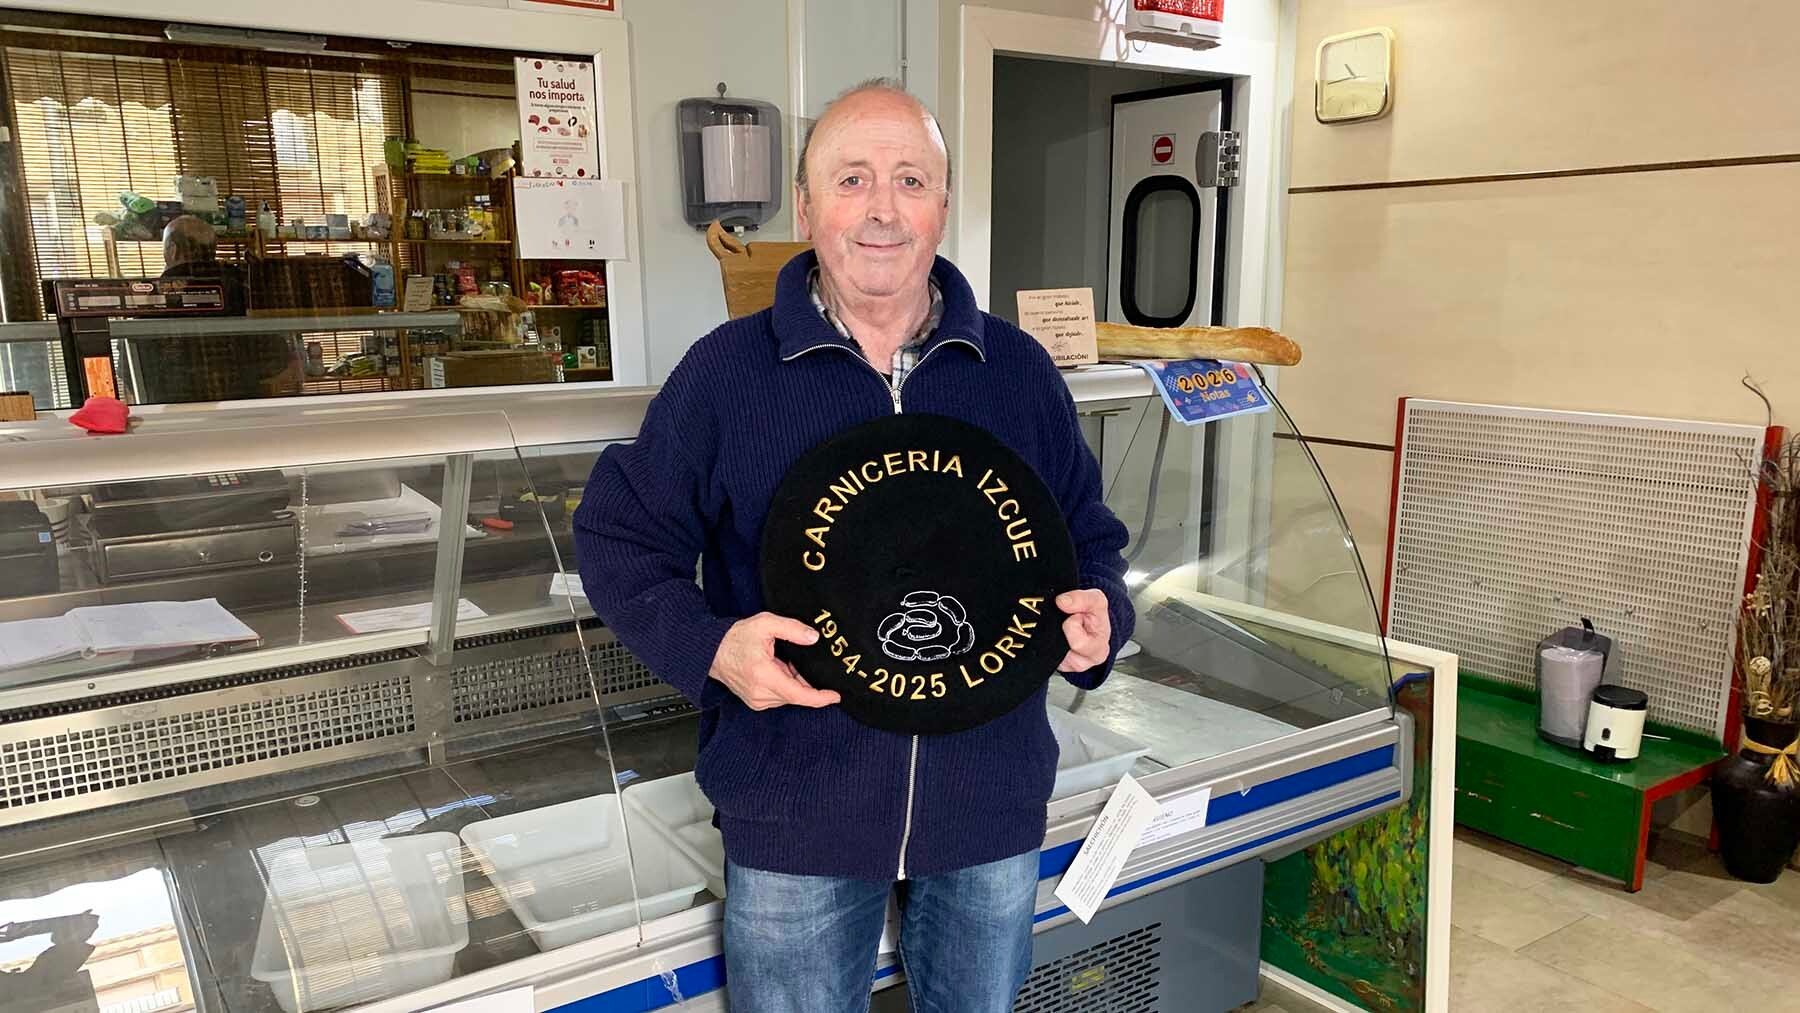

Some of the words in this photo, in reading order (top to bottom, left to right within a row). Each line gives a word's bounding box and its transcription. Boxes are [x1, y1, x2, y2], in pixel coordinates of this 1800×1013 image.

[537, 77, 549, 88] Tu
[551, 78, 576, 90] salud
[529, 90, 547, 100] nos
[548, 90, 585, 103] importa
[1054, 353, 1089, 361] UBILACIÓN!
[1179, 368, 1235, 392] 2026
[1201, 389, 1231, 403] Notas
[803, 450, 964, 571] CARNICERIA
[977, 469, 1038, 562] IZCUE
[814, 609, 947, 700] 1954-2025
[959, 595, 1044, 688] LORKA
